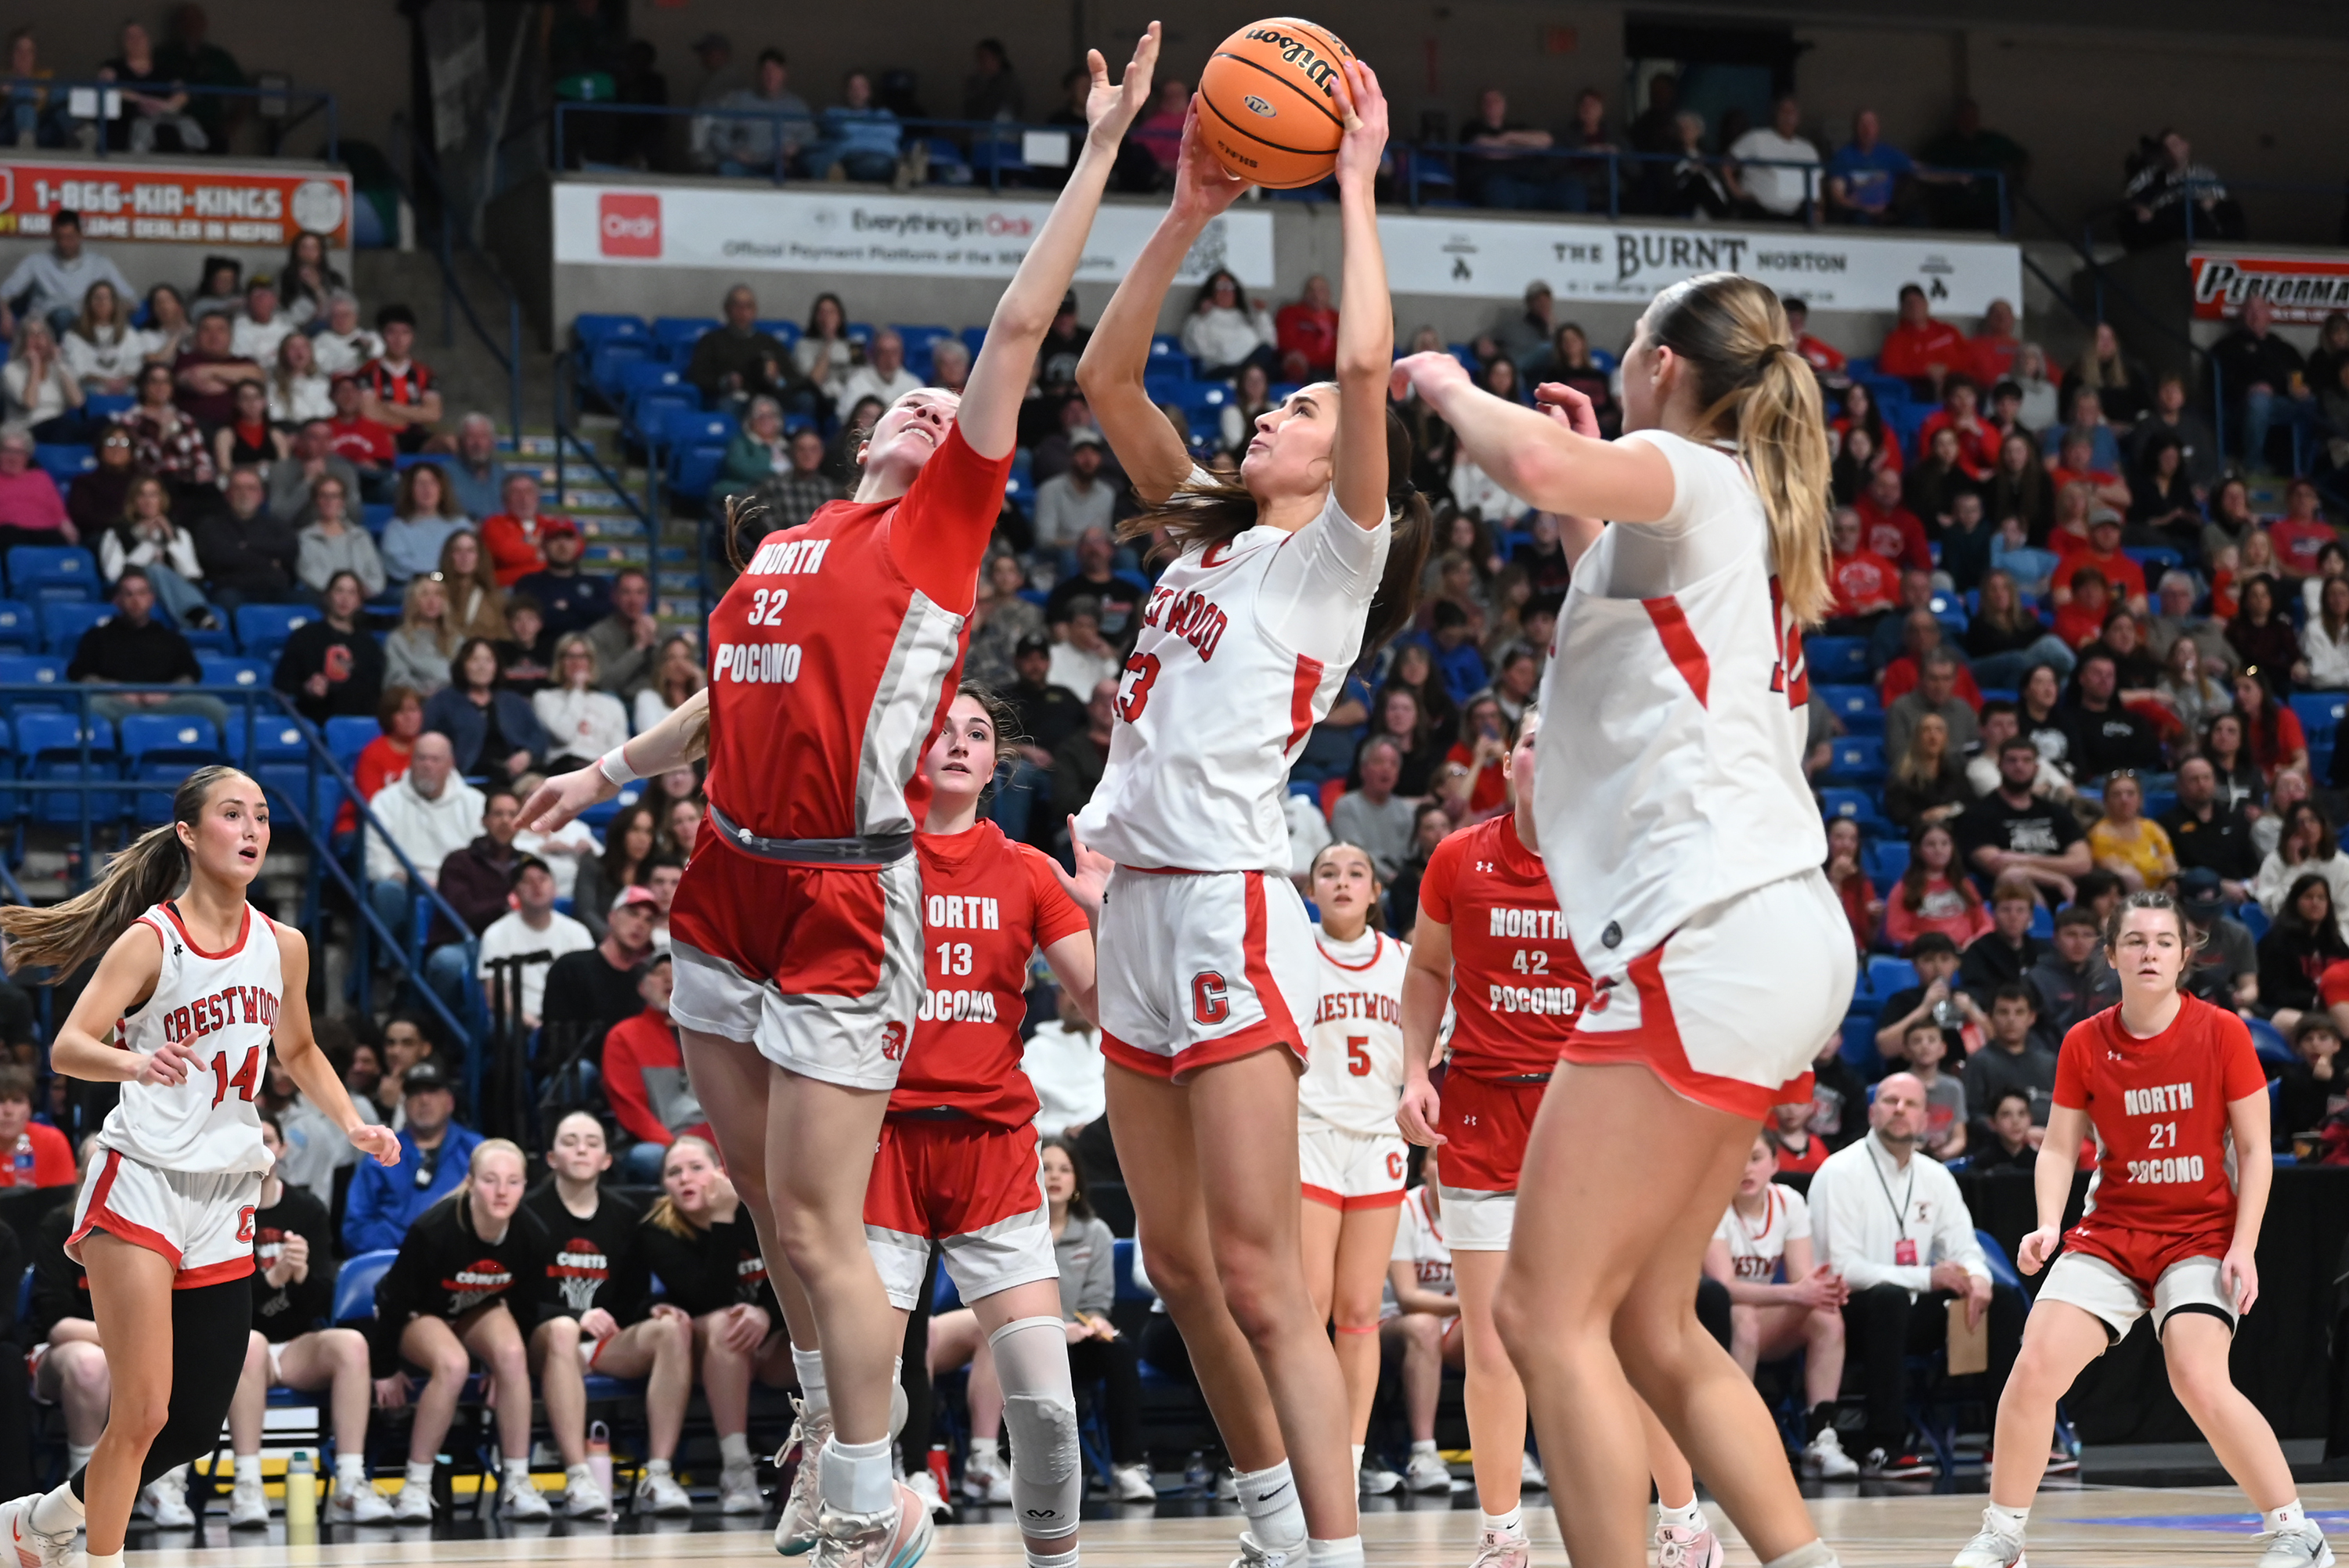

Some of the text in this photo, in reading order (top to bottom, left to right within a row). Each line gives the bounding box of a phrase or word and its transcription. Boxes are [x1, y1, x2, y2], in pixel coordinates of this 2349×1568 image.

[1245, 28, 1339, 98] Wilson
[852, 207, 962, 240] Everything
[965, 210, 983, 235] in
[722, 239, 784, 257] Official
[1554, 234, 1846, 279] THE BURNT NORTON
[745, 539, 832, 575] NORTH
[747, 588, 789, 626] 32
[713, 643, 803, 684] POCONO
[926, 895, 999, 931] ORTH
[1489, 907, 1568, 939] NORTH
[936, 942, 973, 976] 13
[1512, 950, 1550, 975] 42
[918, 989, 998, 1024] OCONO
[1191, 970, 1231, 1026] C
[1489, 984, 1577, 1016] POCONO
[1347, 1036, 1371, 1077] 5
[211, 1044, 260, 1111] 14
[2124, 1081, 2194, 1117] NORTH
[2148, 1121, 2177, 1150] 21
[1386, 1152, 1403, 1180] C
[2127, 1155, 2205, 1185] POCONO
[737, 1256, 764, 1276] ETS
